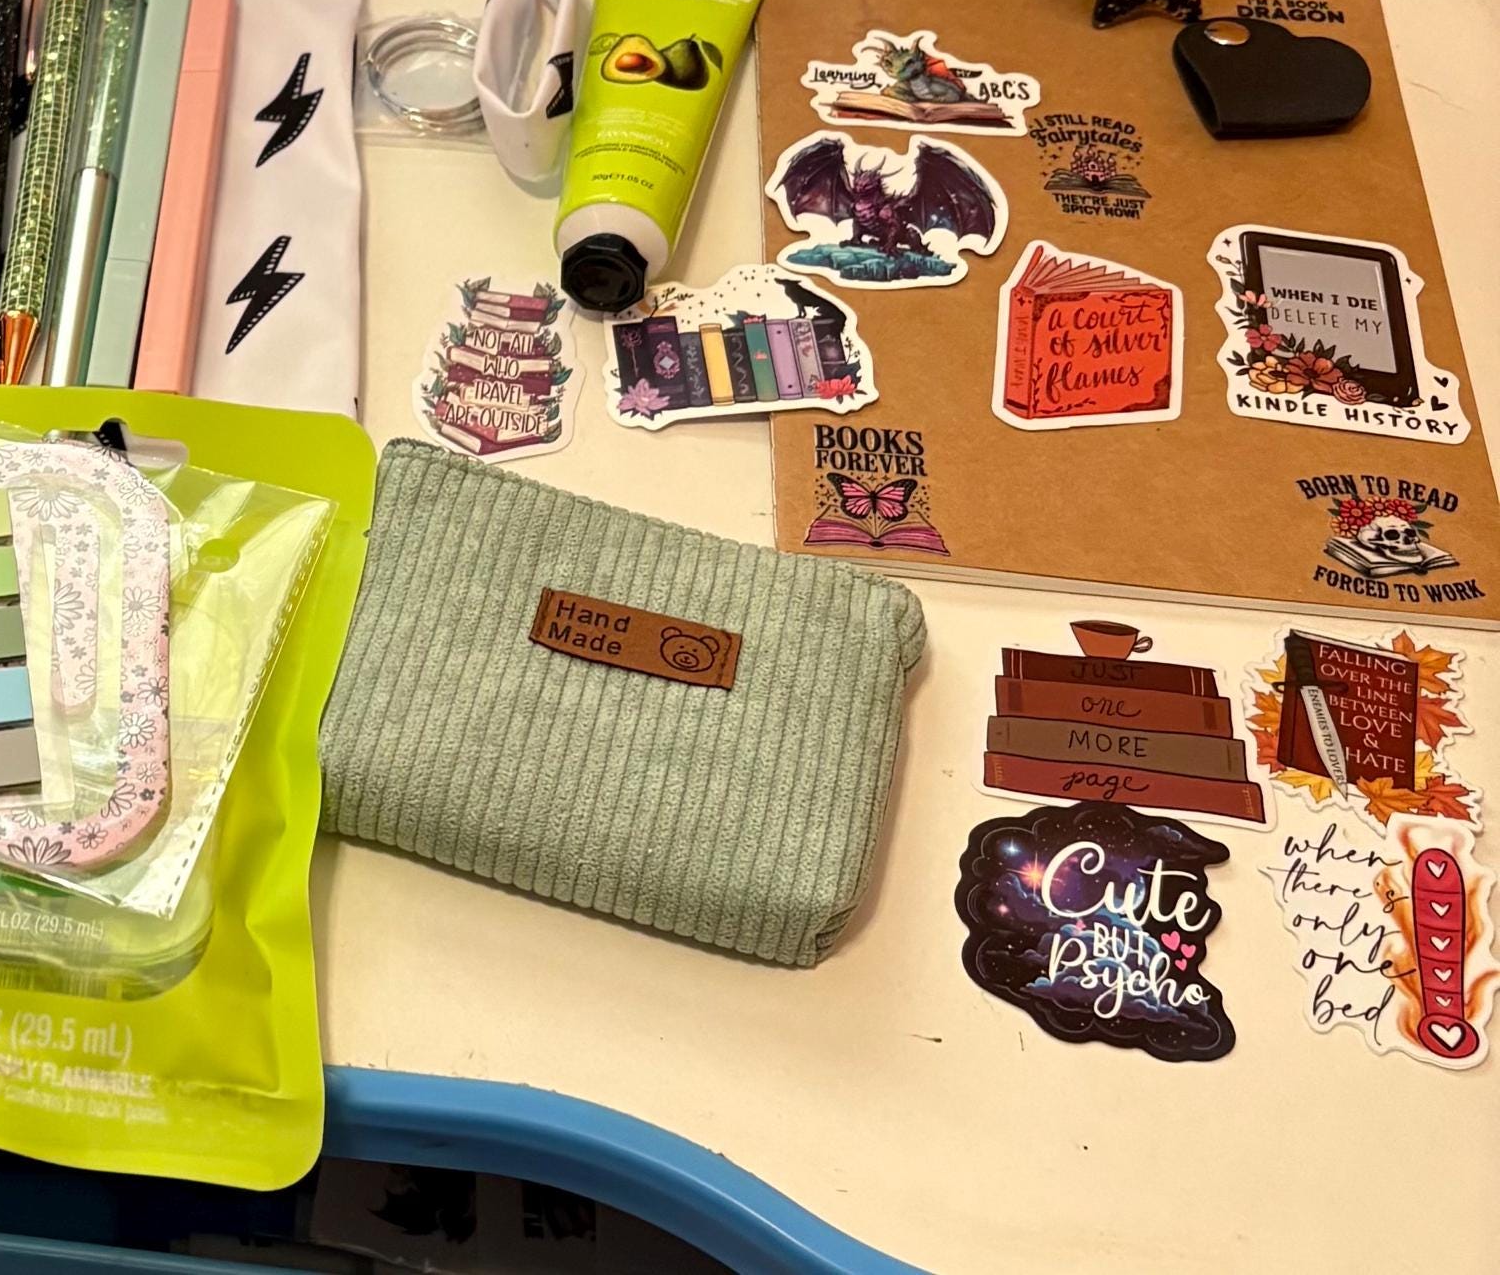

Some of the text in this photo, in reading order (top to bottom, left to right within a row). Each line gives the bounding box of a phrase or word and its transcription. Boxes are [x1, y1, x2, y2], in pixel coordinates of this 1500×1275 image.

[1237, 5, 1345, 24] DRAGON
[1286, 0, 1329, 9] BOOK
[977, 80, 1031, 103] ABC'S
[1044, 114, 1088, 127] STILL
[1091, 115, 1136, 135] READ
[1029, 127, 1143, 153] Fairytales
[1052, 193, 1146, 210] THEY'RE JUST
[1062, 203, 1101, 216] SPICY
[1271, 287, 1378, 311] WHEN I DIE
[1048, 308, 1063, 331] a
[1271, 307, 1383, 335] DELETE MY
[1049, 330, 1076, 358] of
[1083, 327, 1162, 359] silver
[483, 355, 520, 379] WHO
[473, 380, 523, 406] TRAVEL
[1045, 361, 1146, 404] flames
[445, 403, 546, 435] ARE OUTSIDE
[1237, 394, 1459, 436] KINDLE HISTORY
[814, 424, 924, 456] BOOKS
[815, 450, 928, 477] FOREVER
[1295, 475, 1459, 512] BORN TO READ
[1313, 565, 1486, 603] FORCED TO WORK
[556, 599, 631, 633] Hand
[549, 622, 623, 655] Made
[1070, 661, 1144, 682] JUST
[1320, 644, 1407, 675] FALLING
[1320, 662, 1413, 695] OVER THE
[1081, 695, 1142, 718] one
[1329, 694, 1413, 723] BETWEEN
[1357, 685, 1398, 707] LINE
[1308, 688, 1348, 786] ENEMIES TO LOVERS
[1340, 711, 1403, 738] LOVE
[1068, 729, 1150, 758] MORE
[1363, 732, 1380, 750] &
[1345, 746, 1406, 773] HATE
[1059, 772, 1150, 800] page
[1284, 823, 1403, 868] when
[1040, 840, 1211, 932] Cute
[1092, 922, 1152, 966] BUT
[1292, 902, 1400, 964] only
[1049, 933, 1211, 1019] Psycho
[1302, 948, 1417, 979] one
[1312, 974, 1395, 1046] bed
[9, 1011, 76, 1052] (29.5
[82, 1022, 133, 1067] mL)
